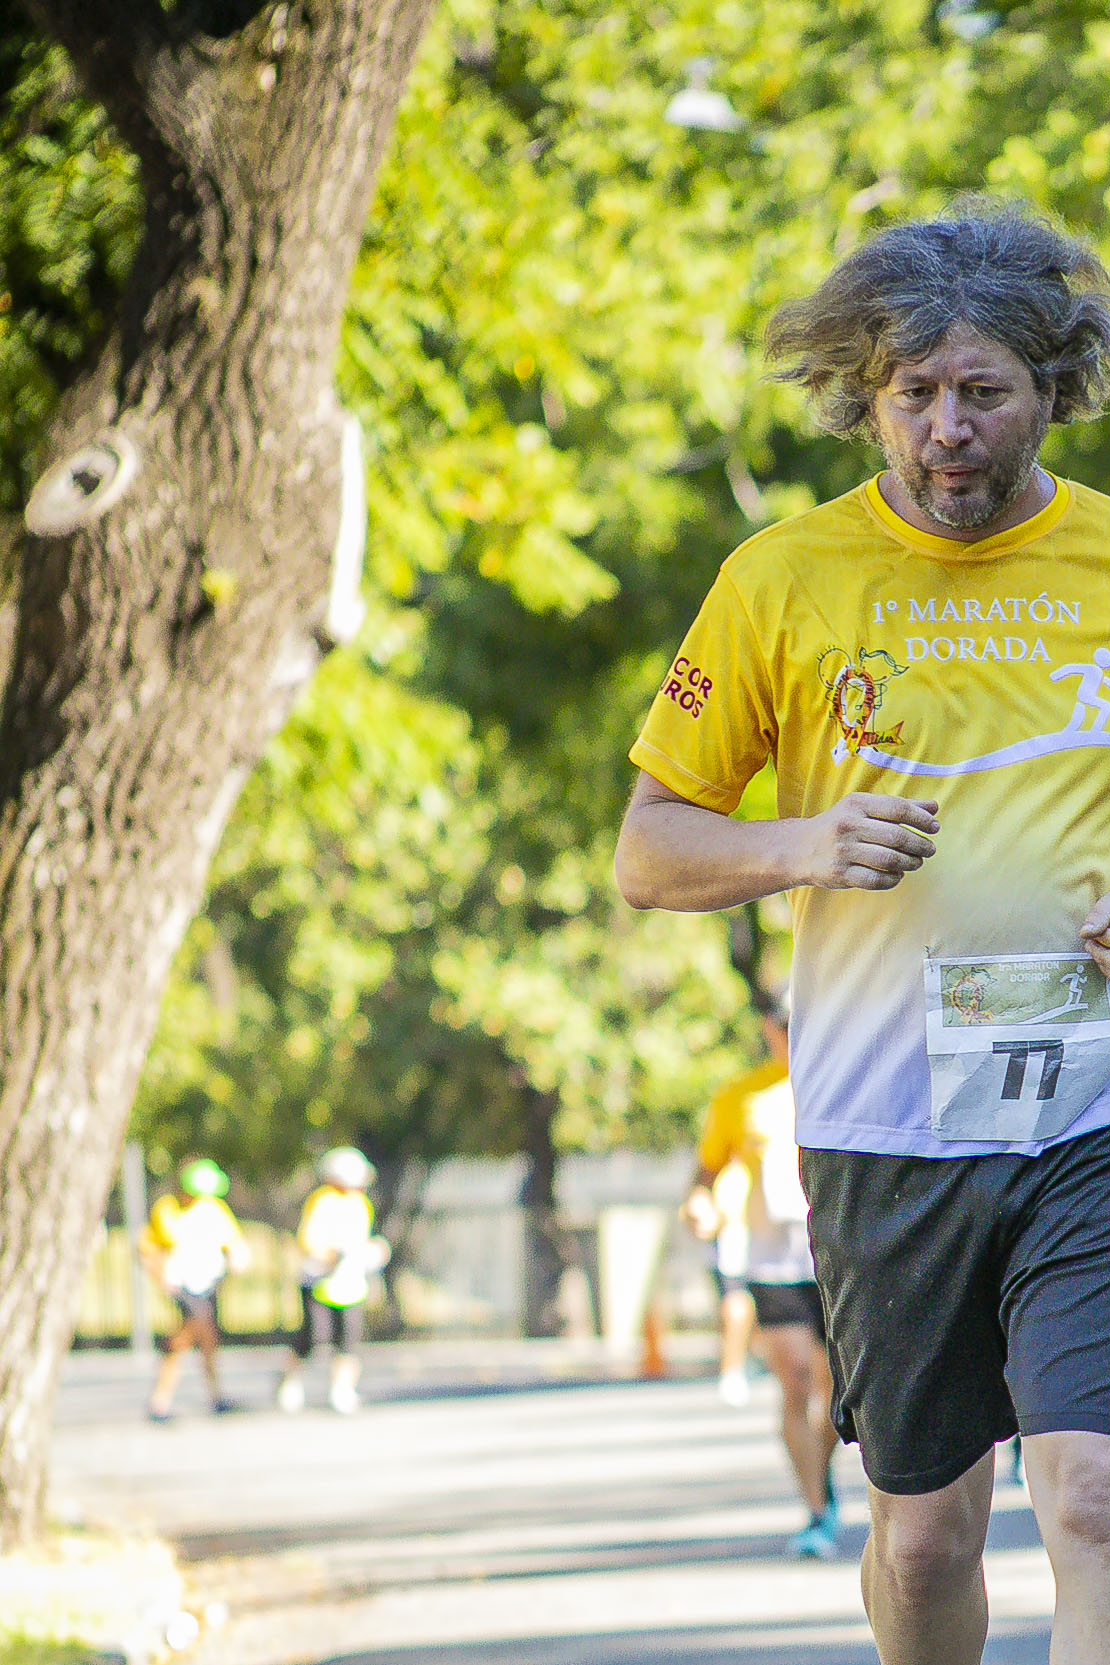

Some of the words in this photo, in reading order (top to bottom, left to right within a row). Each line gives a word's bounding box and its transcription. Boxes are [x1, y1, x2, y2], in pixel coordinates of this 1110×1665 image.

[907, 591, 1081, 626] MARATÓN
[904, 635, 1051, 662] DORADA
[992, 1038, 1064, 1100] 77
